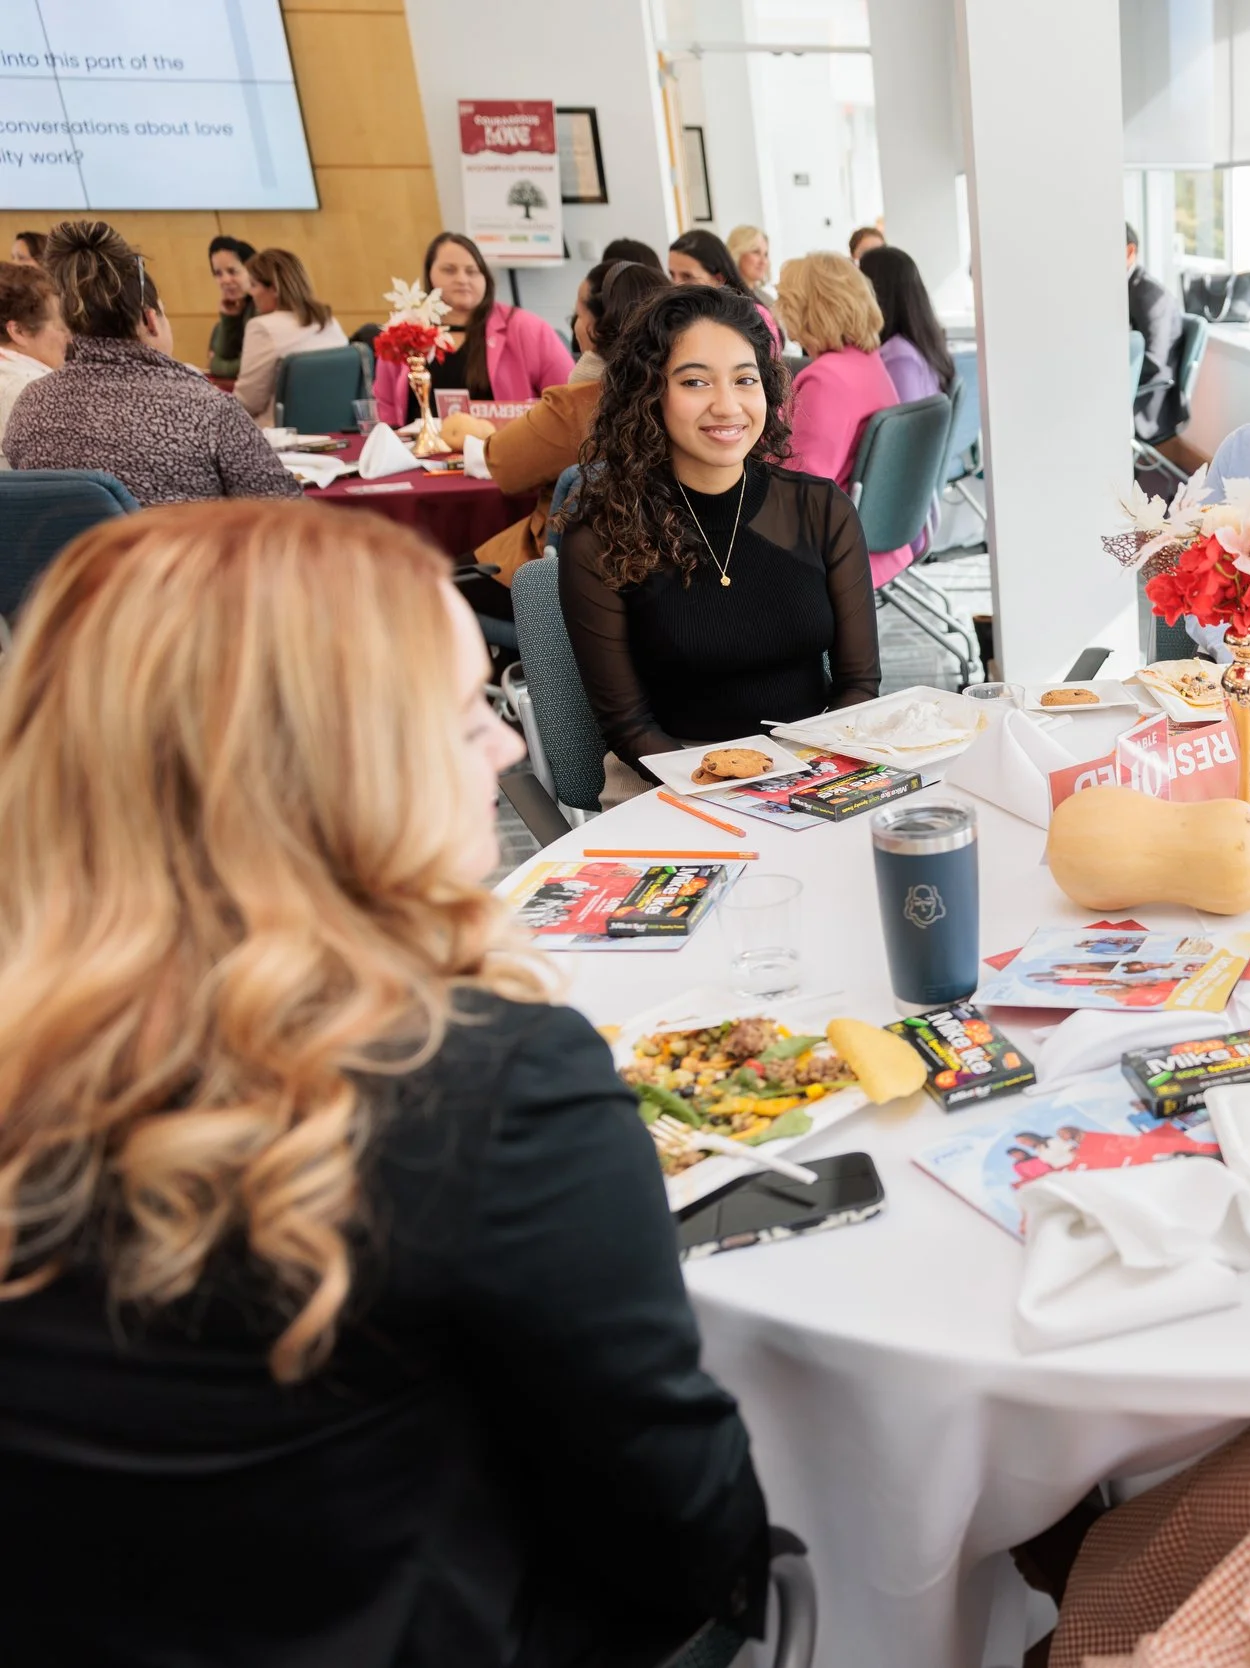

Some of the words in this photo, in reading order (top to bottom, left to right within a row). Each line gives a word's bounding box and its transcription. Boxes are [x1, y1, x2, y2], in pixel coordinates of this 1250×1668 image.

[1, 51, 39, 68] into
[44, 52, 79, 68] this
[85, 55, 124, 72] part
[130, 55, 147, 71] of
[153, 55, 184, 71] the
[134, 121, 190, 136] about
[194, 121, 234, 137] love
[0, 149, 23, 168] ity
[29, 149, 83, 166] work?
[470, 403, 533, 419] SERVED
[1136, 731, 1158, 750] ABLE
[849, 769, 899, 787] Mike
[662, 867, 700, 895] Mike
[644, 896, 676, 915] Ike
[927, 1011, 973, 1049] Mike
[960, 1046, 992, 1075] Ike
[1146, 1048, 1231, 1075] Mike
